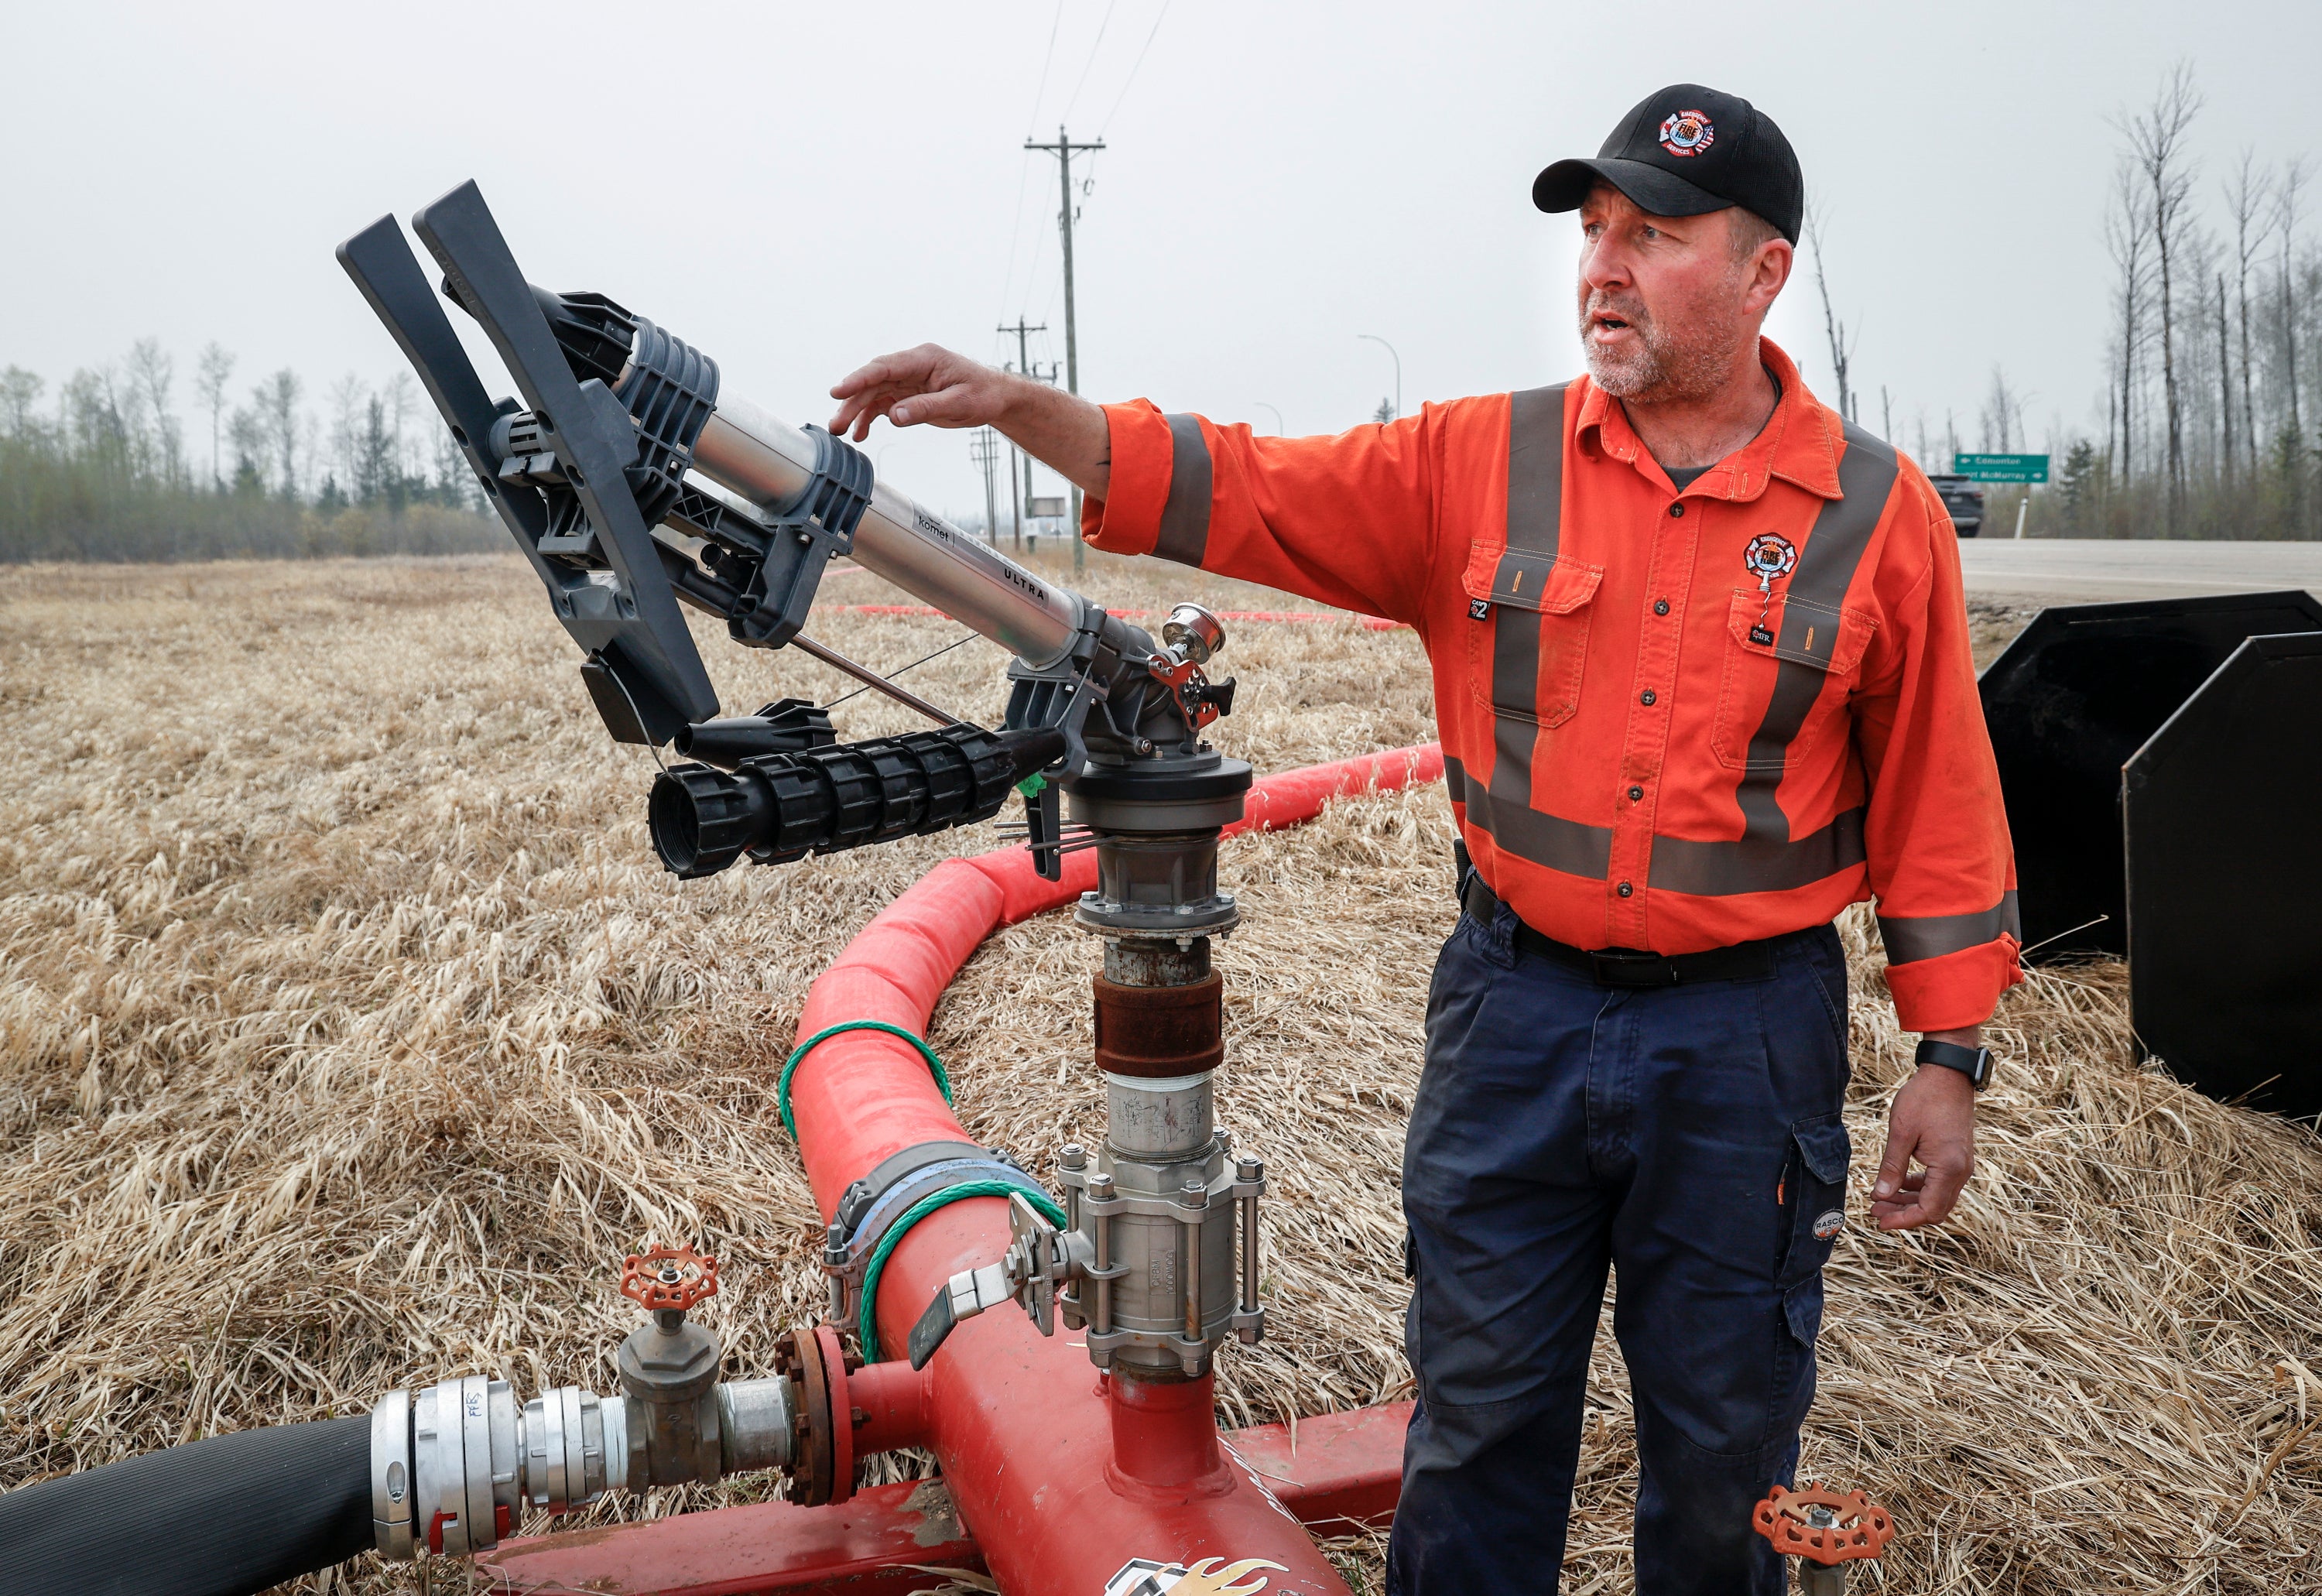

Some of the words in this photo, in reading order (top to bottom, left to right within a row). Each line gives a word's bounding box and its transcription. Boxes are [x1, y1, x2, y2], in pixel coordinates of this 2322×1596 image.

[1679, 124, 1698, 135] FIRE
[1676, 132, 1694, 142] FLOOD
[1666, 144, 1690, 155] SERVICES
[1981, 471, 2026, 480] McMurray
[919, 515, 949, 542] komet
[1004, 568, 1044, 600] ULTRA
[1762, 550, 1780, 560] FIRE
[1476, 601, 1488, 618] 2
[1759, 632, 1771, 642] IFR
[1816, 1216, 1844, 1229] RASCO
[1166, 1252, 1175, 1294] 1000WOG
